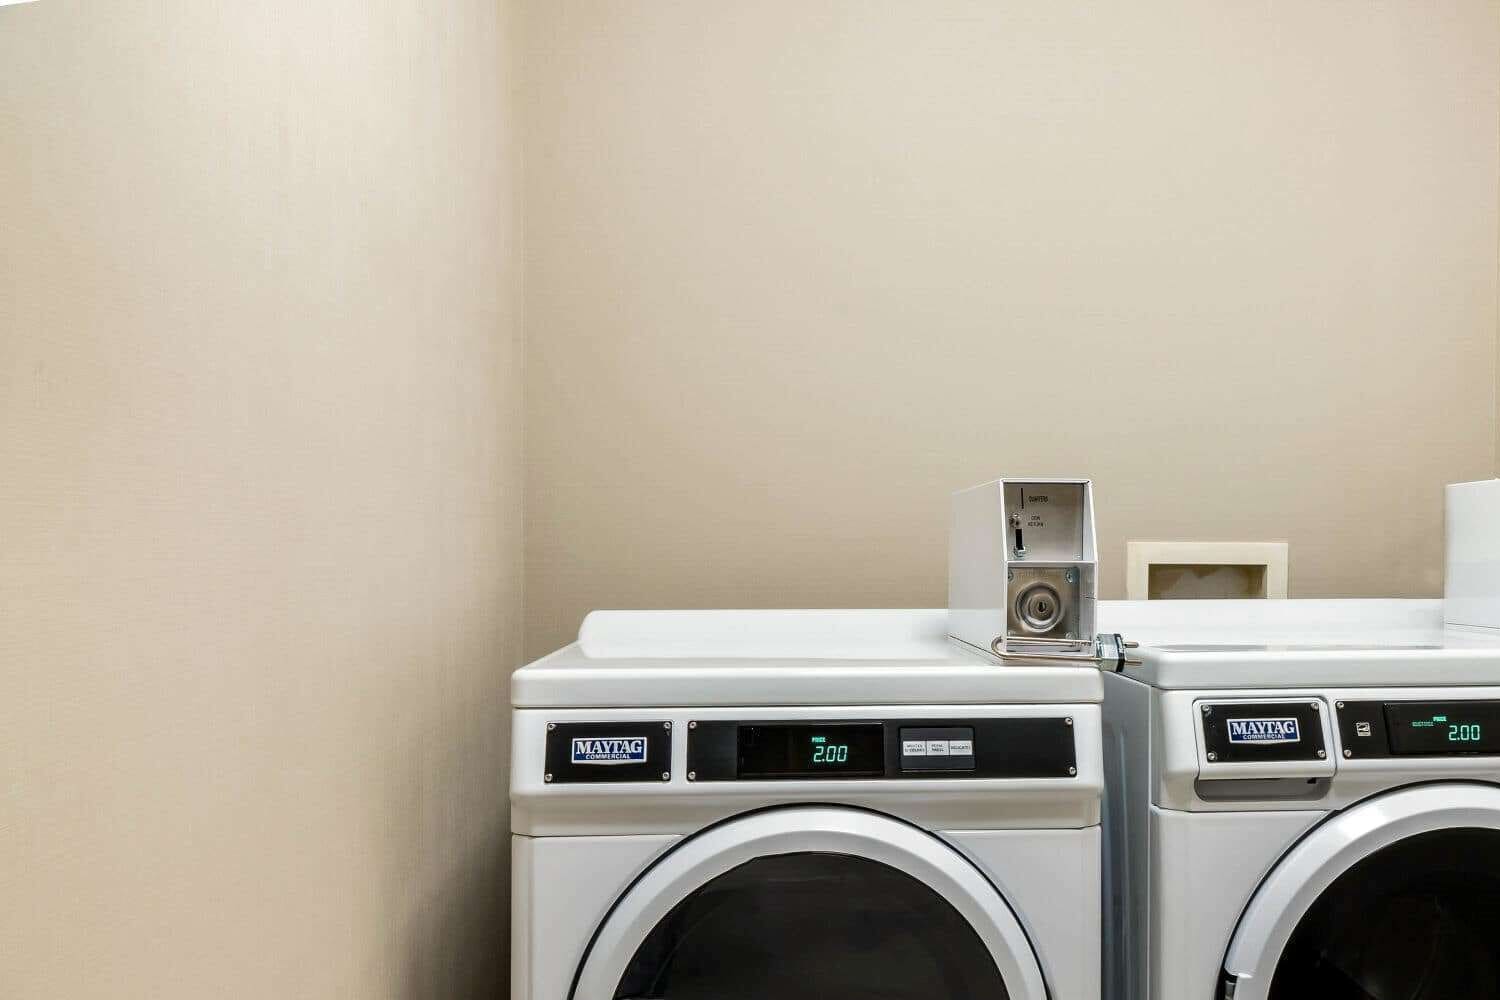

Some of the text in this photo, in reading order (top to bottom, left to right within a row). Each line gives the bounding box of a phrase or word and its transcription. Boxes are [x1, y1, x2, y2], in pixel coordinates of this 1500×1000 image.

[1231, 721, 1295, 735] MAYTAG
[1448, 725, 1480, 741] 2.00
[575, 740, 643, 755] MAYTAG
[813, 745, 848, 762] 2.00
